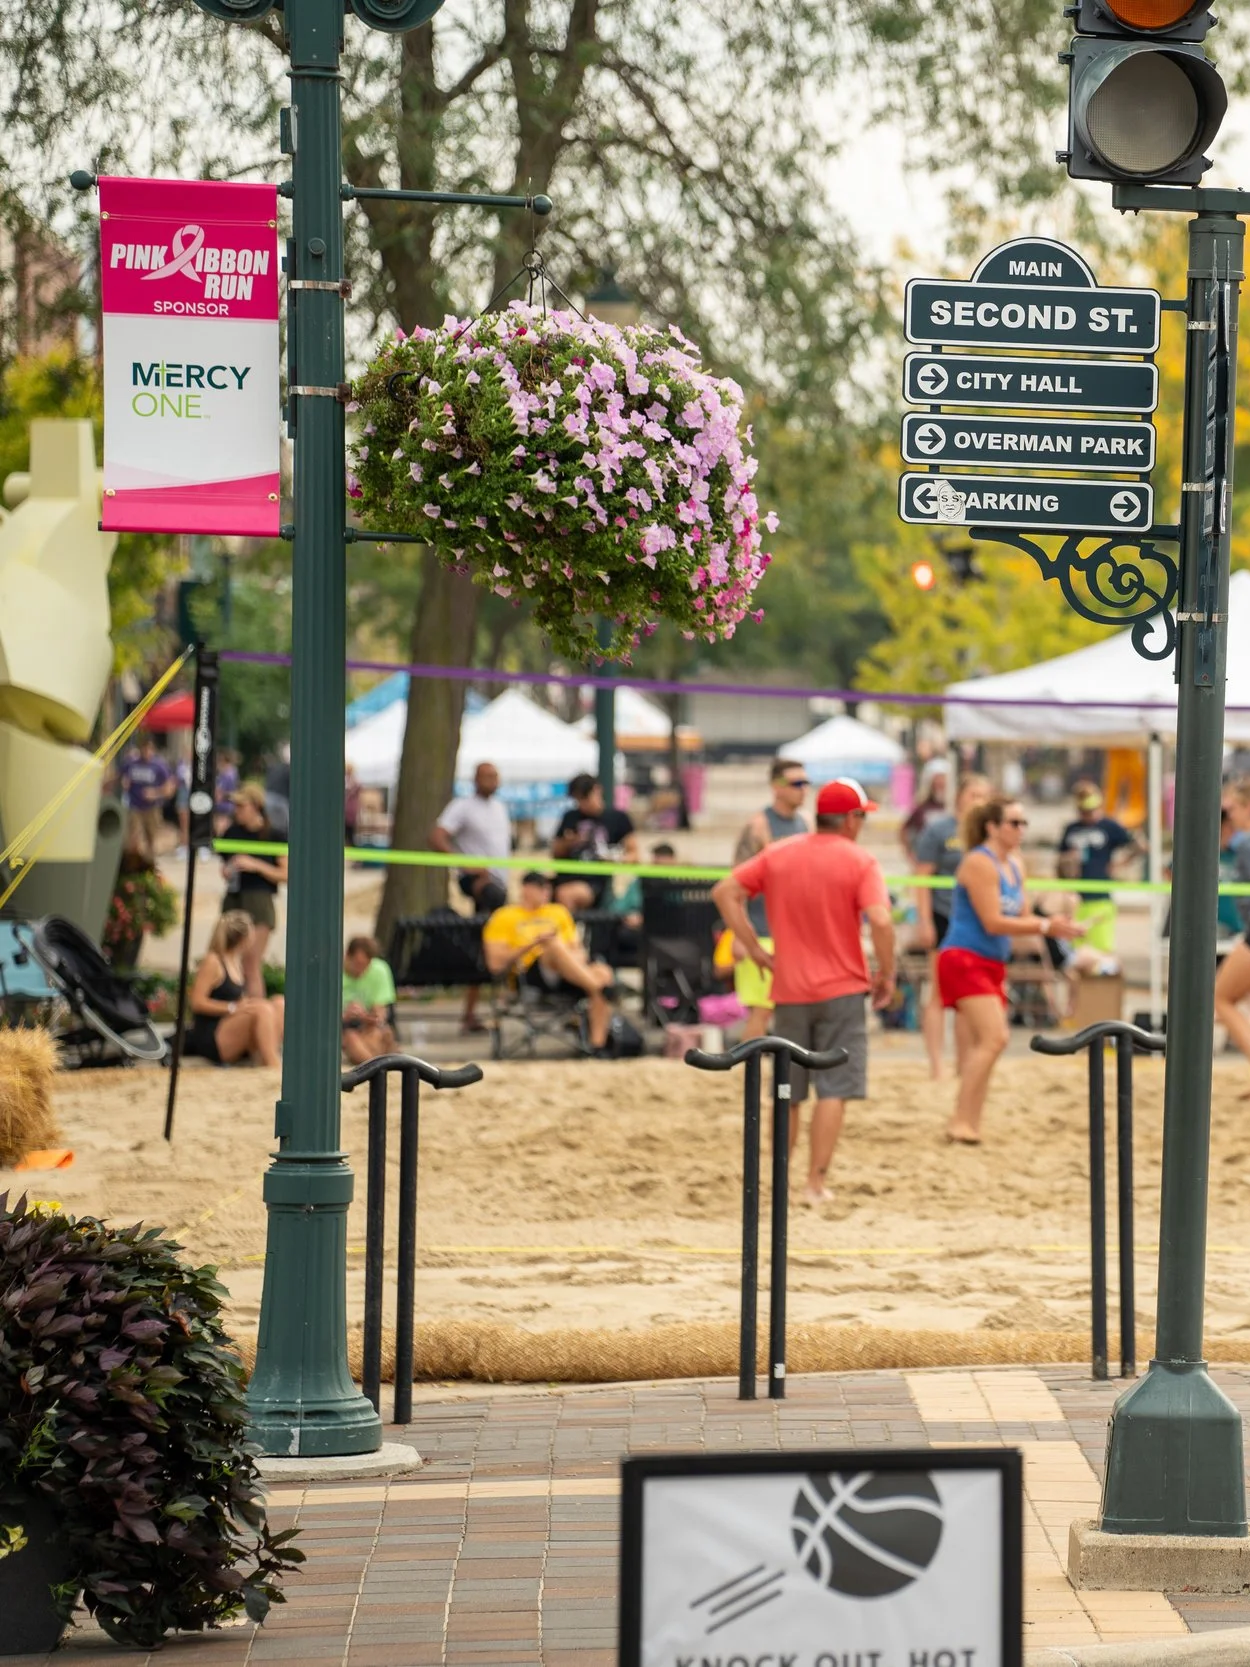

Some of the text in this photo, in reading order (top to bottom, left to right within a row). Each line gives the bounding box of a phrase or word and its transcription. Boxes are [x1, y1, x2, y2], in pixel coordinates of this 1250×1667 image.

[110, 243, 168, 270] PINK
[1008, 260, 1063, 278] MAIN
[204, 275, 254, 301] RUN
[153, 300, 229, 316] SPONSOR
[929, 299, 1138, 334] SECOND ST.
[131, 361, 252, 391] MERCY
[956, 371, 1083, 394] CITY HALL
[131, 391, 202, 420] ONE
[953, 431, 1145, 456] OVERMAN PARK
[910, 1649, 977, 1667] HOT
